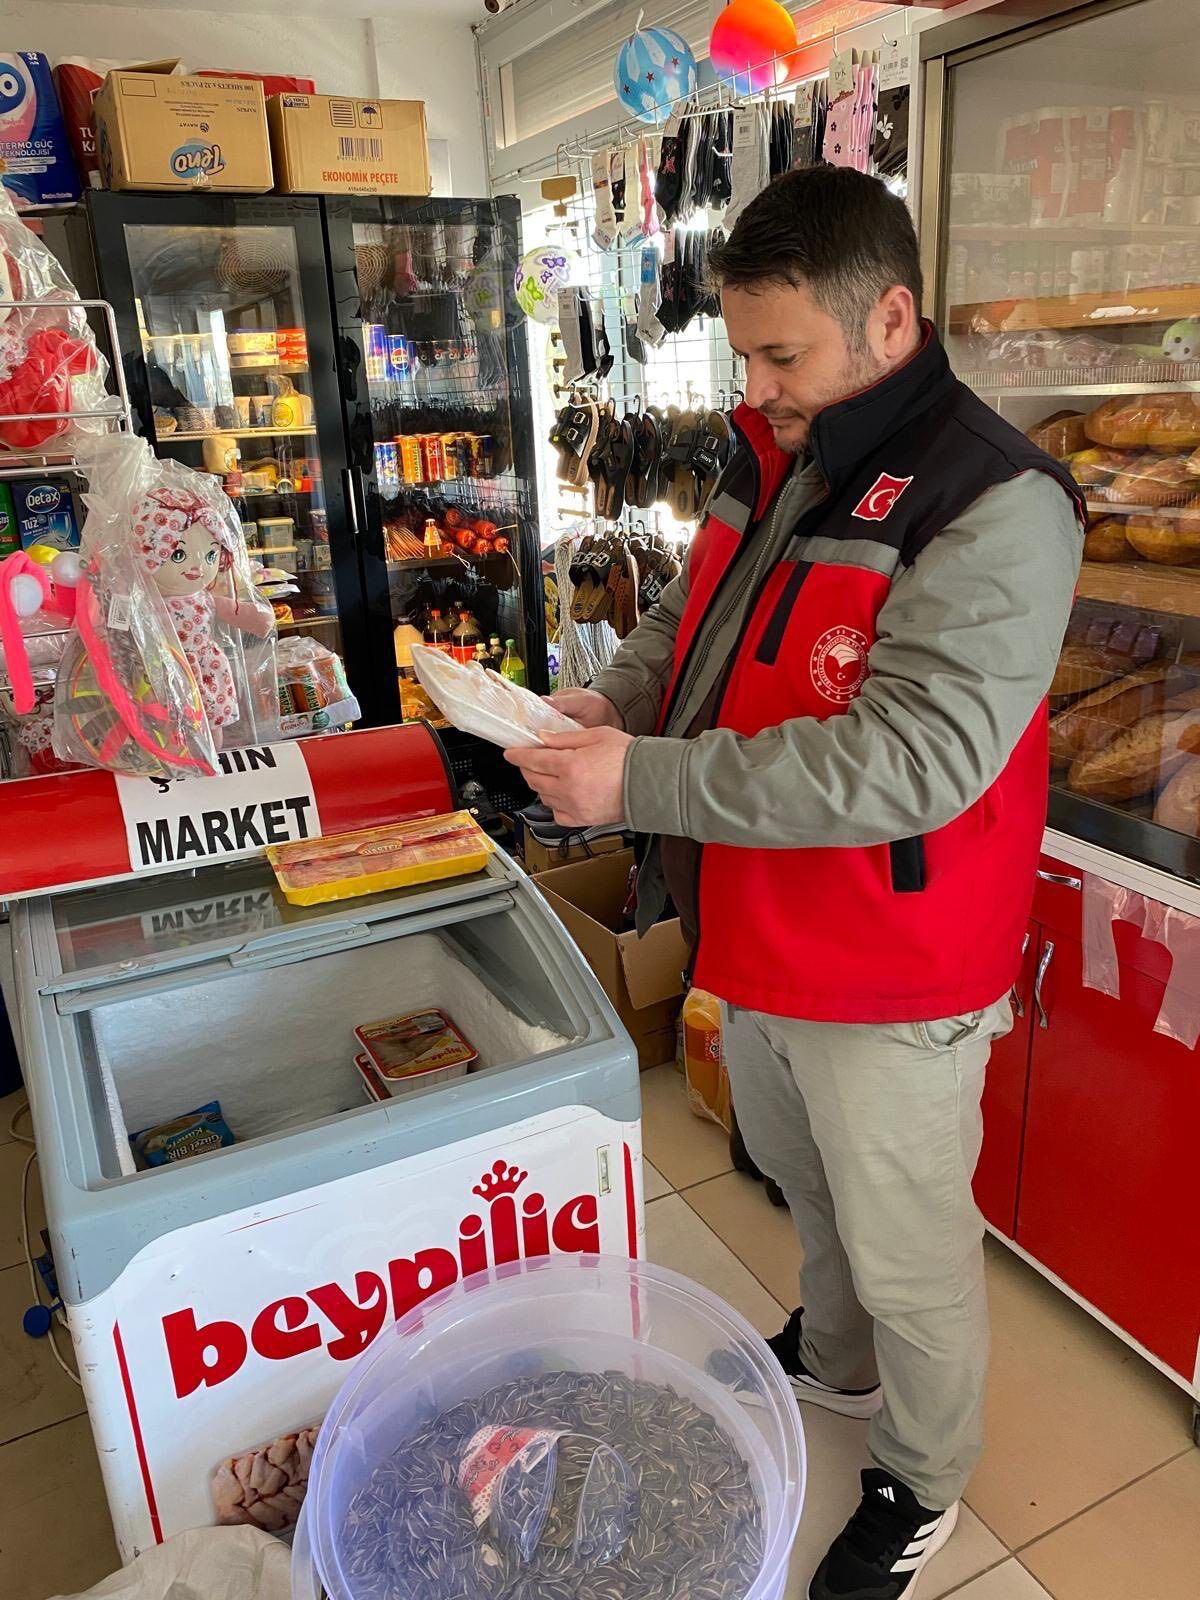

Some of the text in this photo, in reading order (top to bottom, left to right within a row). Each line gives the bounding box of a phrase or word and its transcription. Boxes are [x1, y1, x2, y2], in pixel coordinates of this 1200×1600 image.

[26, 52, 38, 61] 32
[34, 139, 54, 151] GÜÇ
[173, 144, 225, 176] Teno
[322, 170, 399, 186] EKONOMİK PEÇETE
[28, 491, 59, 507] Detax
[136, 795, 311, 865] MARKET
